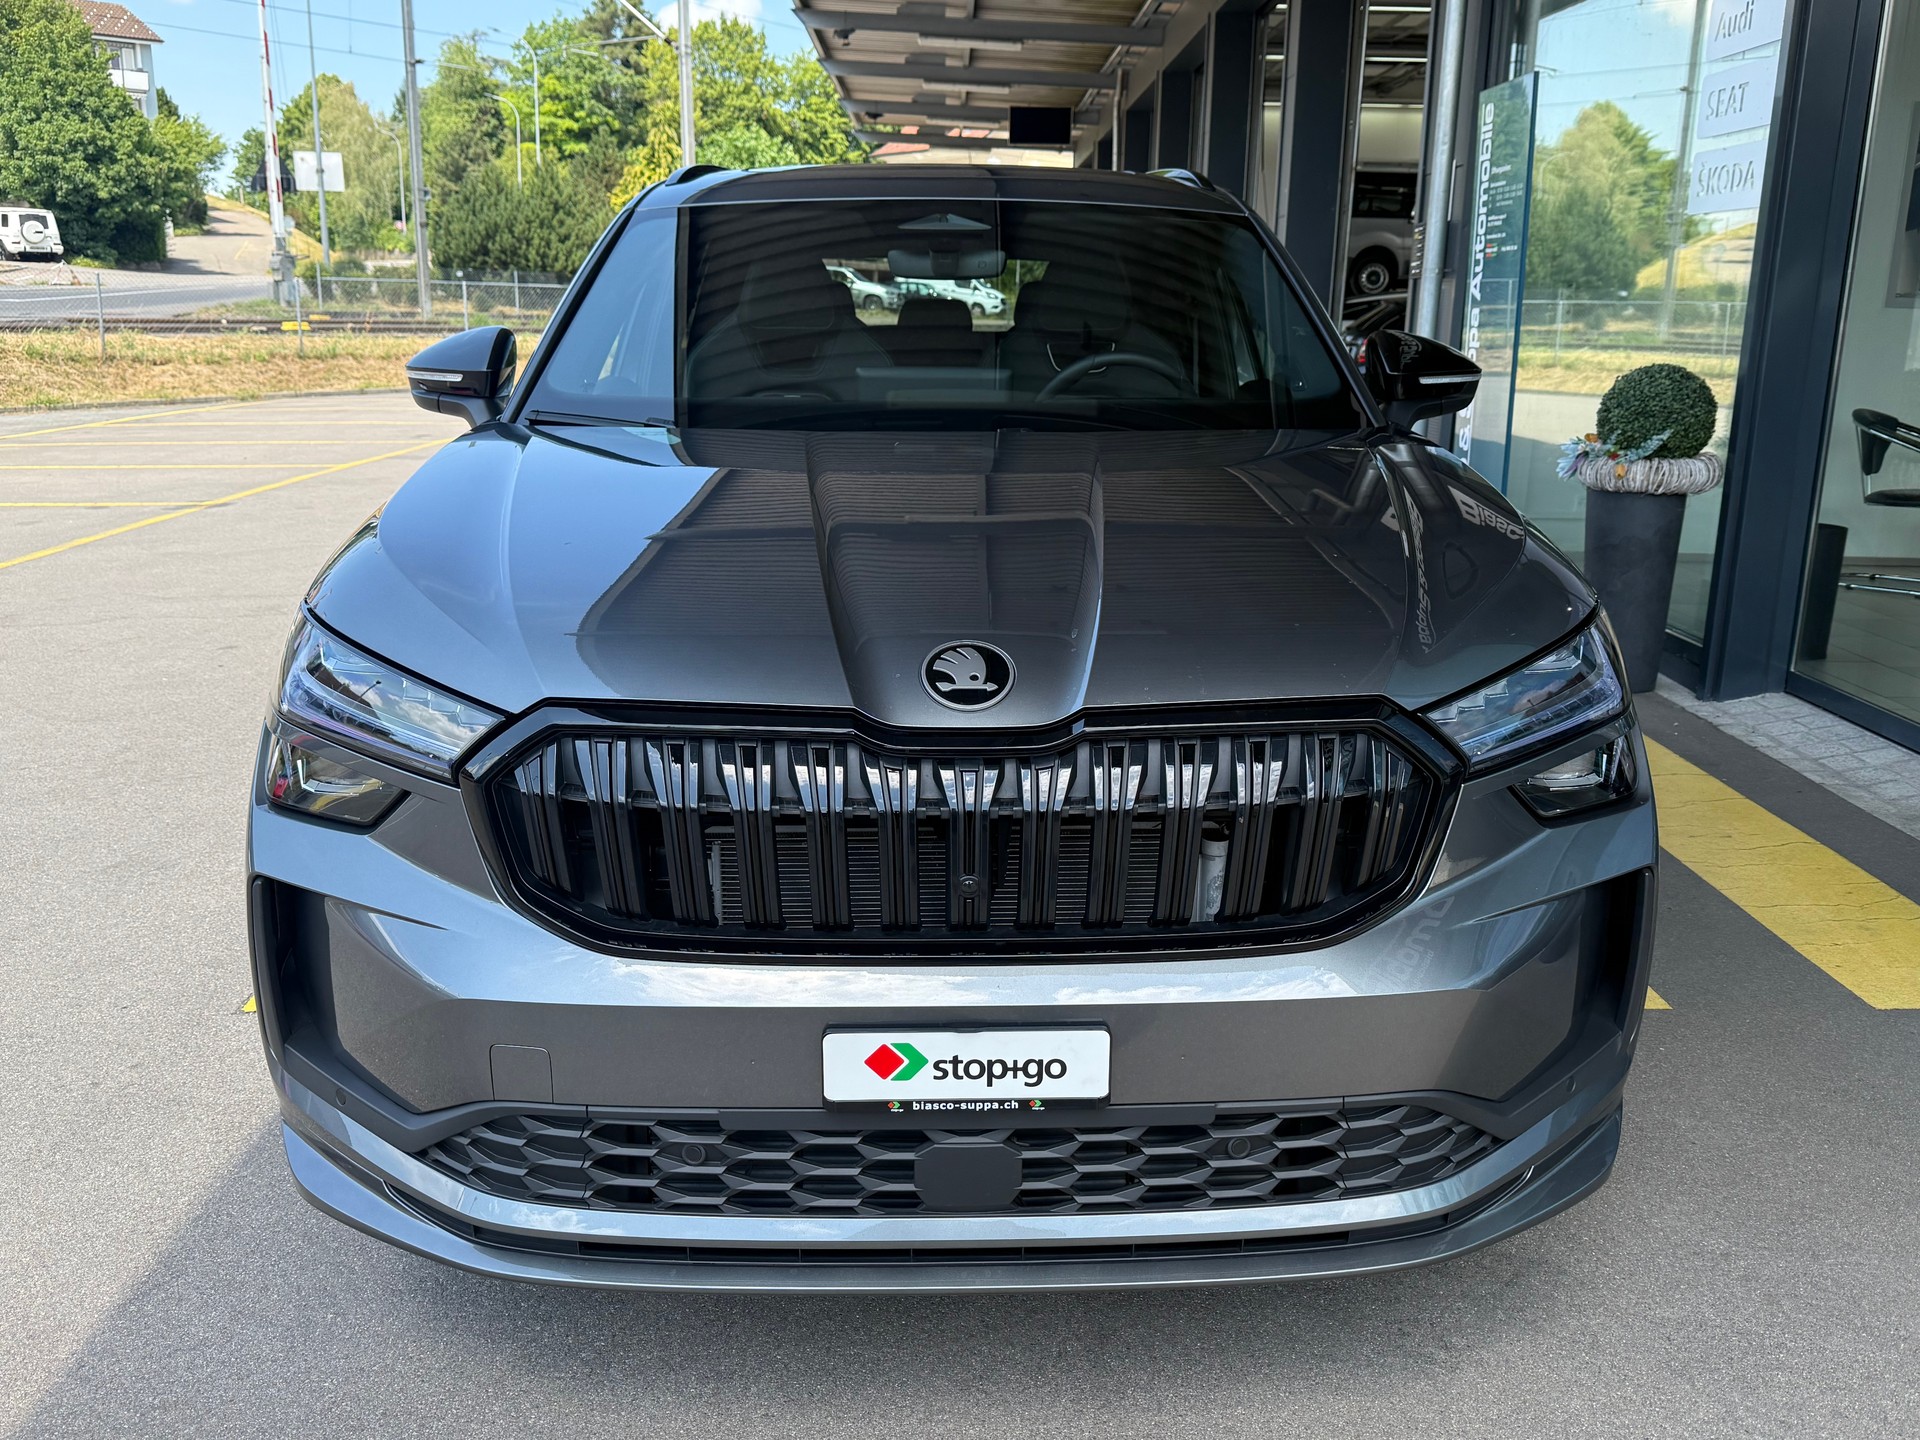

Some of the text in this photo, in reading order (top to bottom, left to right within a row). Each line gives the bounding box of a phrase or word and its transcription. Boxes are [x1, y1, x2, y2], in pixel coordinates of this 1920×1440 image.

[1714, 1, 1755, 42] Audi
[1705, 81, 1750, 121] SEAT
[1696, 160, 1756, 198] ŠKODA
[1469, 102, 1495, 300] Automobile
[932, 1054, 1068, 1088] stop+go
[912, 1100, 1019, 1112] biasco-suppa.ch
